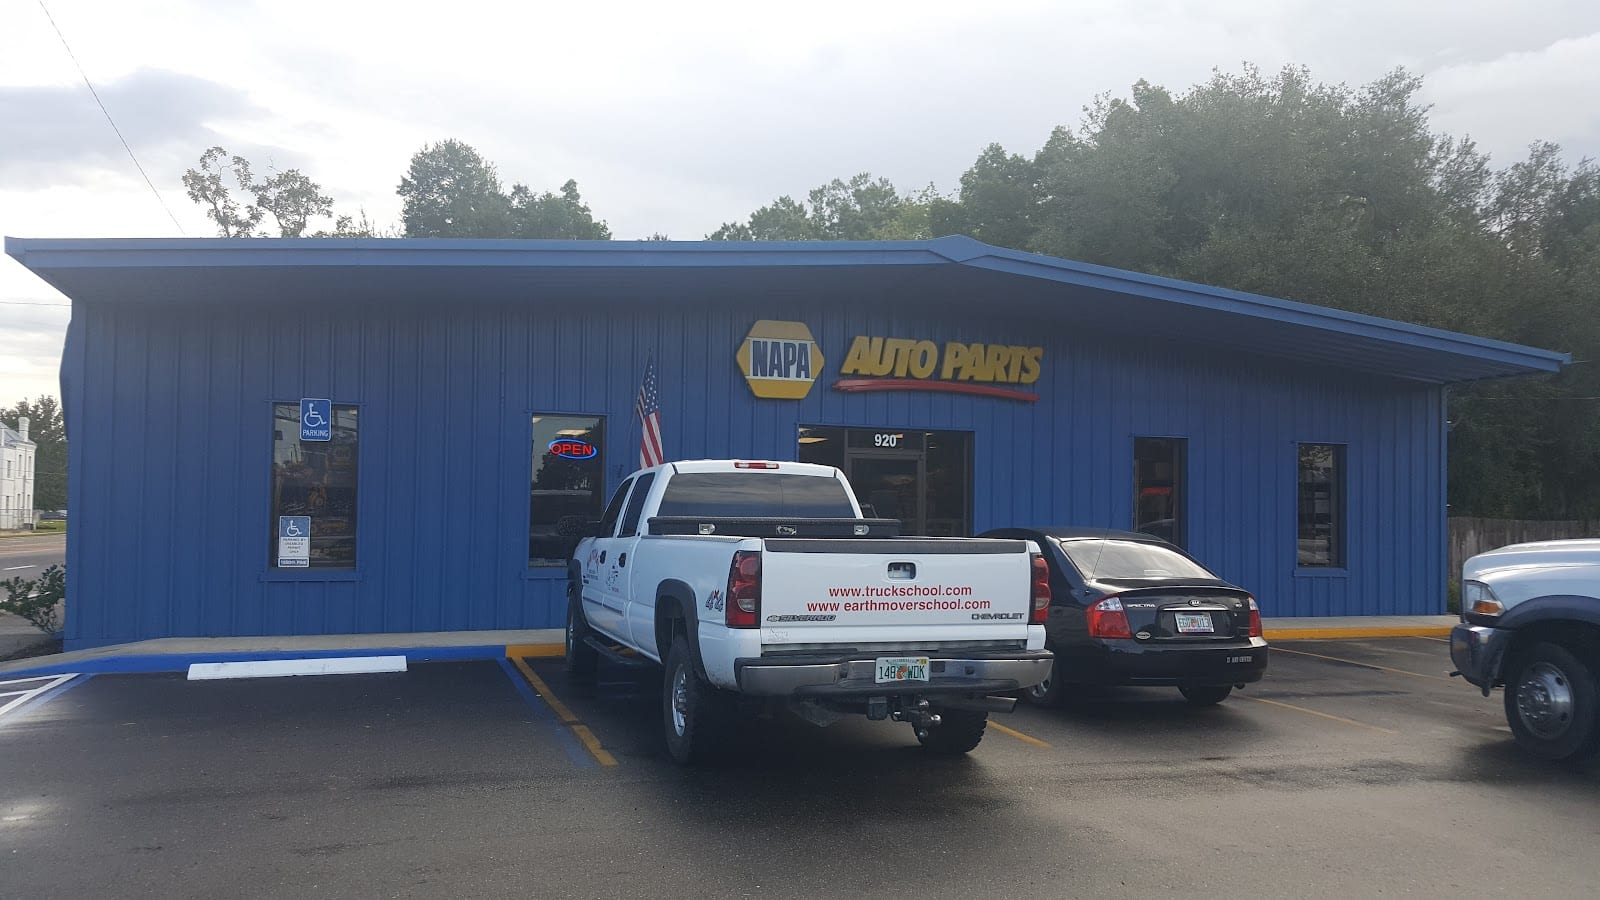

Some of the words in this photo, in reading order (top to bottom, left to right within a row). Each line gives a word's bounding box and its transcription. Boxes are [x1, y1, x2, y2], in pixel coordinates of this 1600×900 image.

[752, 340, 811, 379] NAPA
[840, 335, 938, 379] AUTO
[940, 341, 1044, 384] PARTS
[302, 429, 329, 437] PARKING
[874, 433, 897, 447] 920
[551, 443, 592, 455] OPEN
[828, 584, 973, 598] www.truckschool.com
[779, 614, 837, 622] SILVERADO
[971, 612, 1025, 621] CHEVROLET
